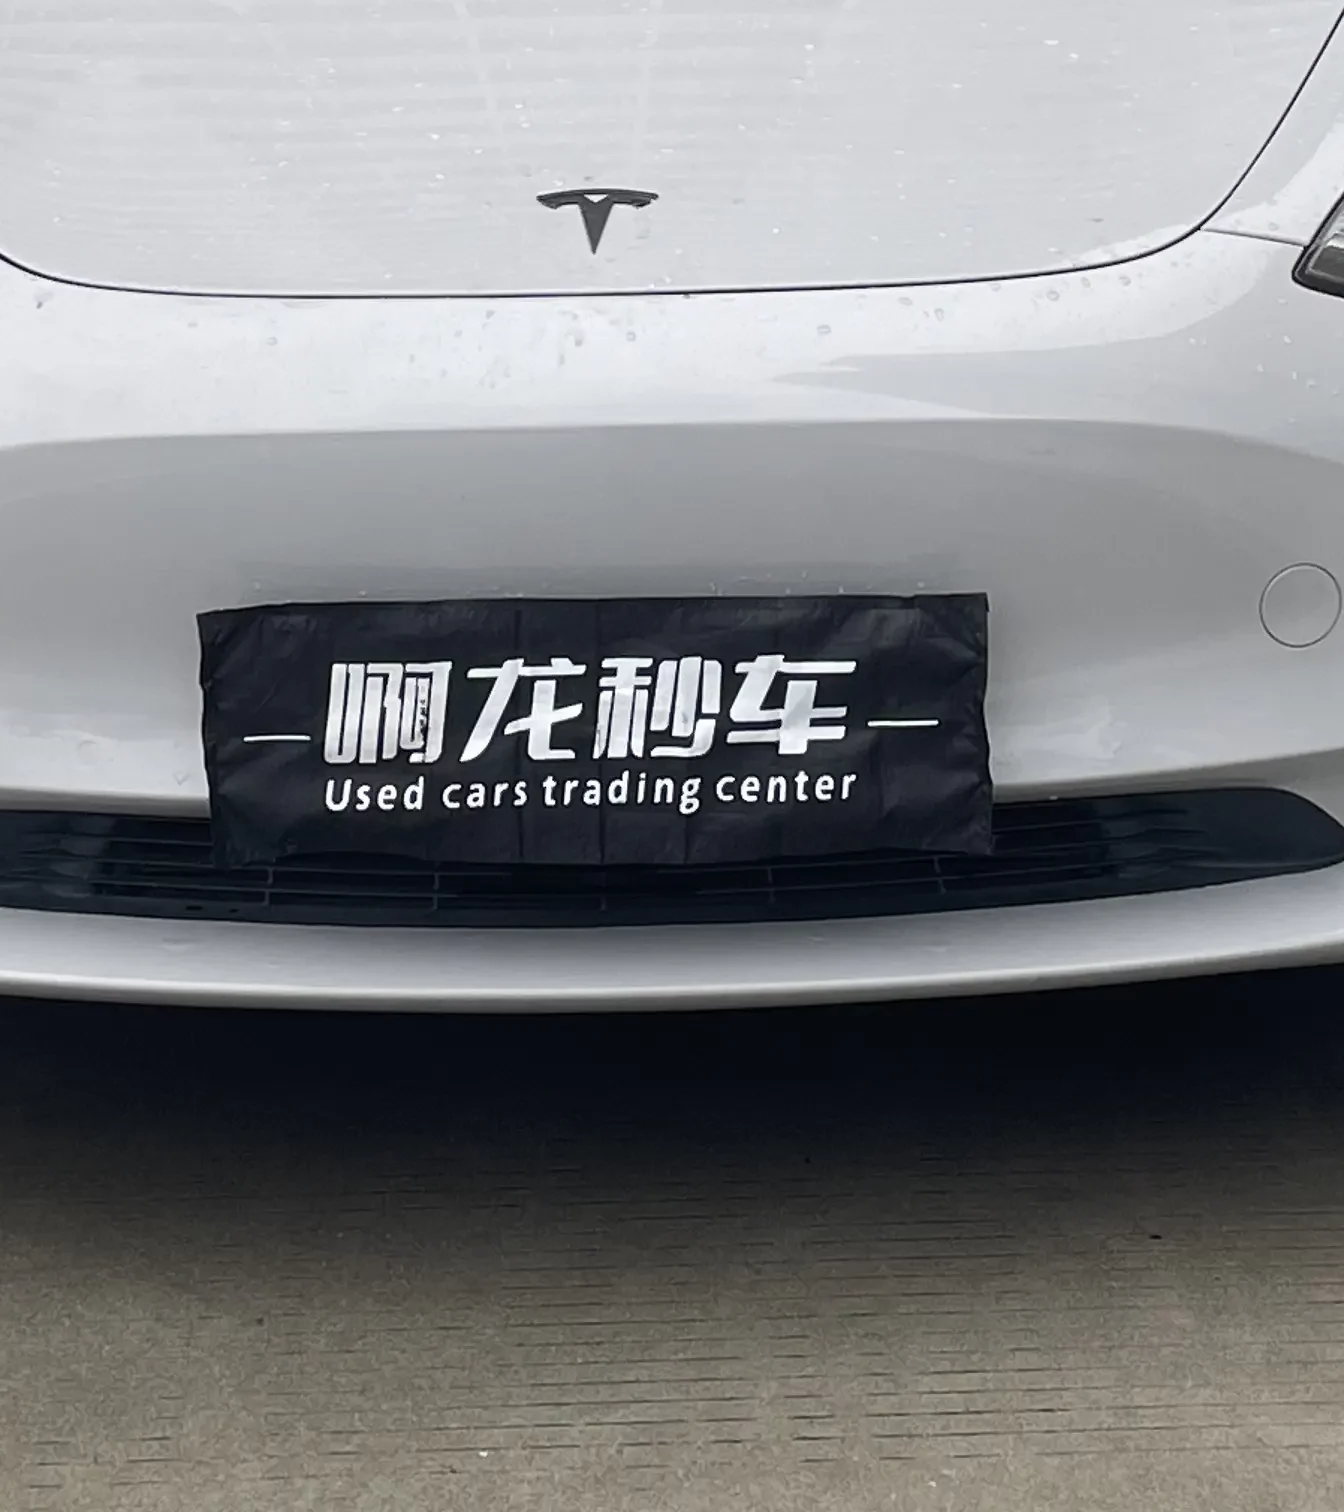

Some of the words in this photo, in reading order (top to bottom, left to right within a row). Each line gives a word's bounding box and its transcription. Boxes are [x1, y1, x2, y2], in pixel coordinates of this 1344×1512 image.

[324, 654, 857, 764] 啊龙秒车
[324, 776, 424, 812] Used
[442, 777, 529, 809] cars
[543, 769, 702, 815] trading
[715, 770, 857, 803] center
